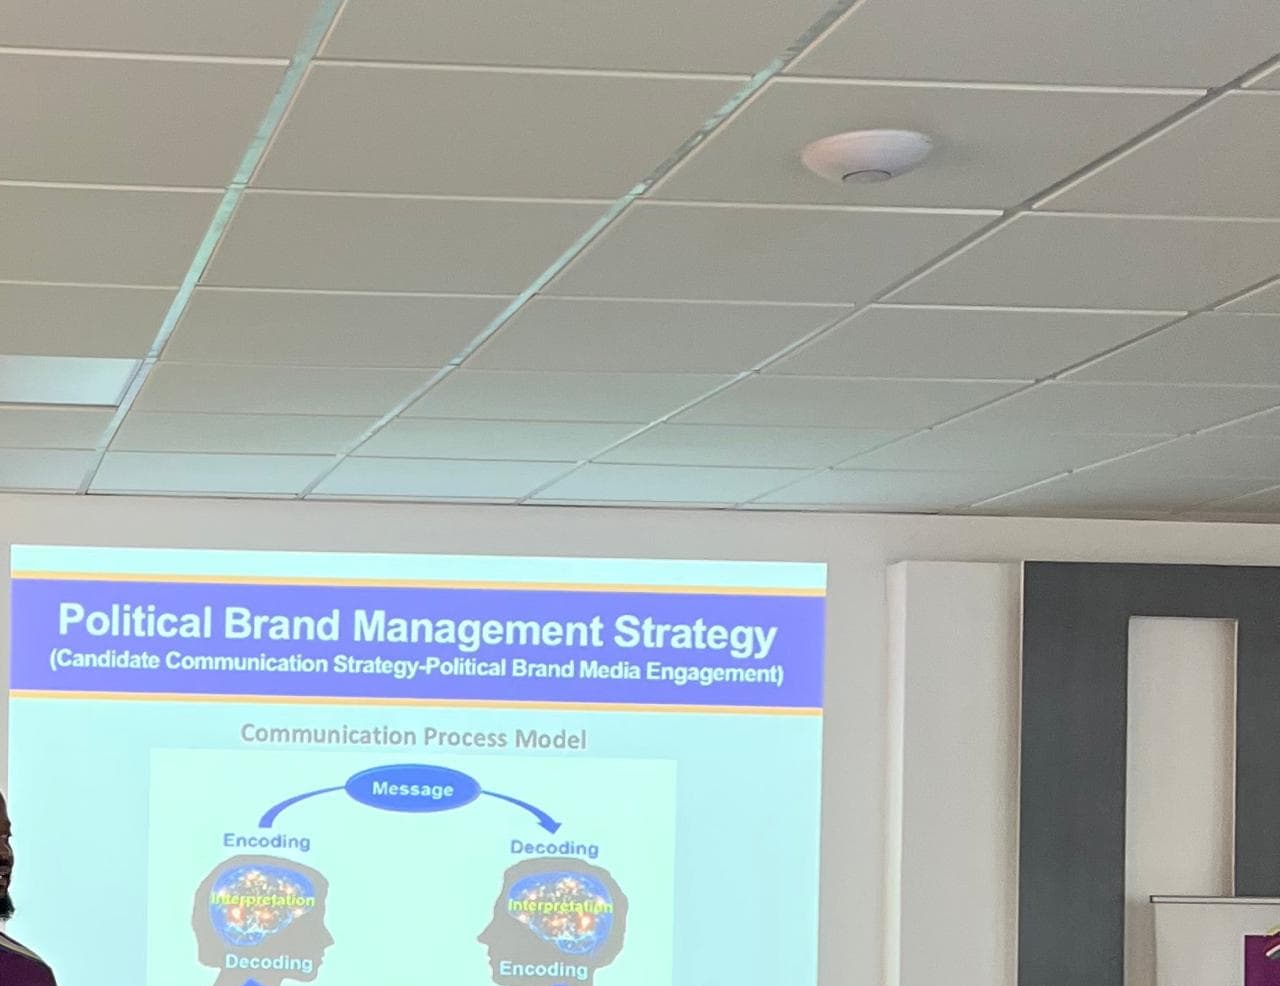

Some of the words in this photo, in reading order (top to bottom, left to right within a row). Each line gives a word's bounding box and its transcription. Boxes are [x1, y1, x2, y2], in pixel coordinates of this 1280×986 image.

[59, 602, 212, 638] Political
[225, 606, 339, 641] Brand
[353, 609, 604, 652] Management
[614, 614, 778, 659] Strategy
[50, 647, 160, 671] (Candidate
[165, 651, 328, 673] Communication
[333, 654, 506, 679] Strategy-Political
[512, 658, 574, 678] Brand
[579, 660, 640, 680] Media
[646, 662, 784, 687] Engagement)
[240, 723, 418, 748] Communication
[424, 726, 508, 748] Process
[515, 728, 587, 751] Model
[372, 781, 454, 799] Message
[223, 833, 311, 852] Encoding
[510, 840, 600, 859] Decoding
[211, 893, 315, 909] Interpretation
[507, 898, 614, 914] Interpretation
[225, 954, 314, 973] Decoding
[499, 960, 589, 979] Encoding
